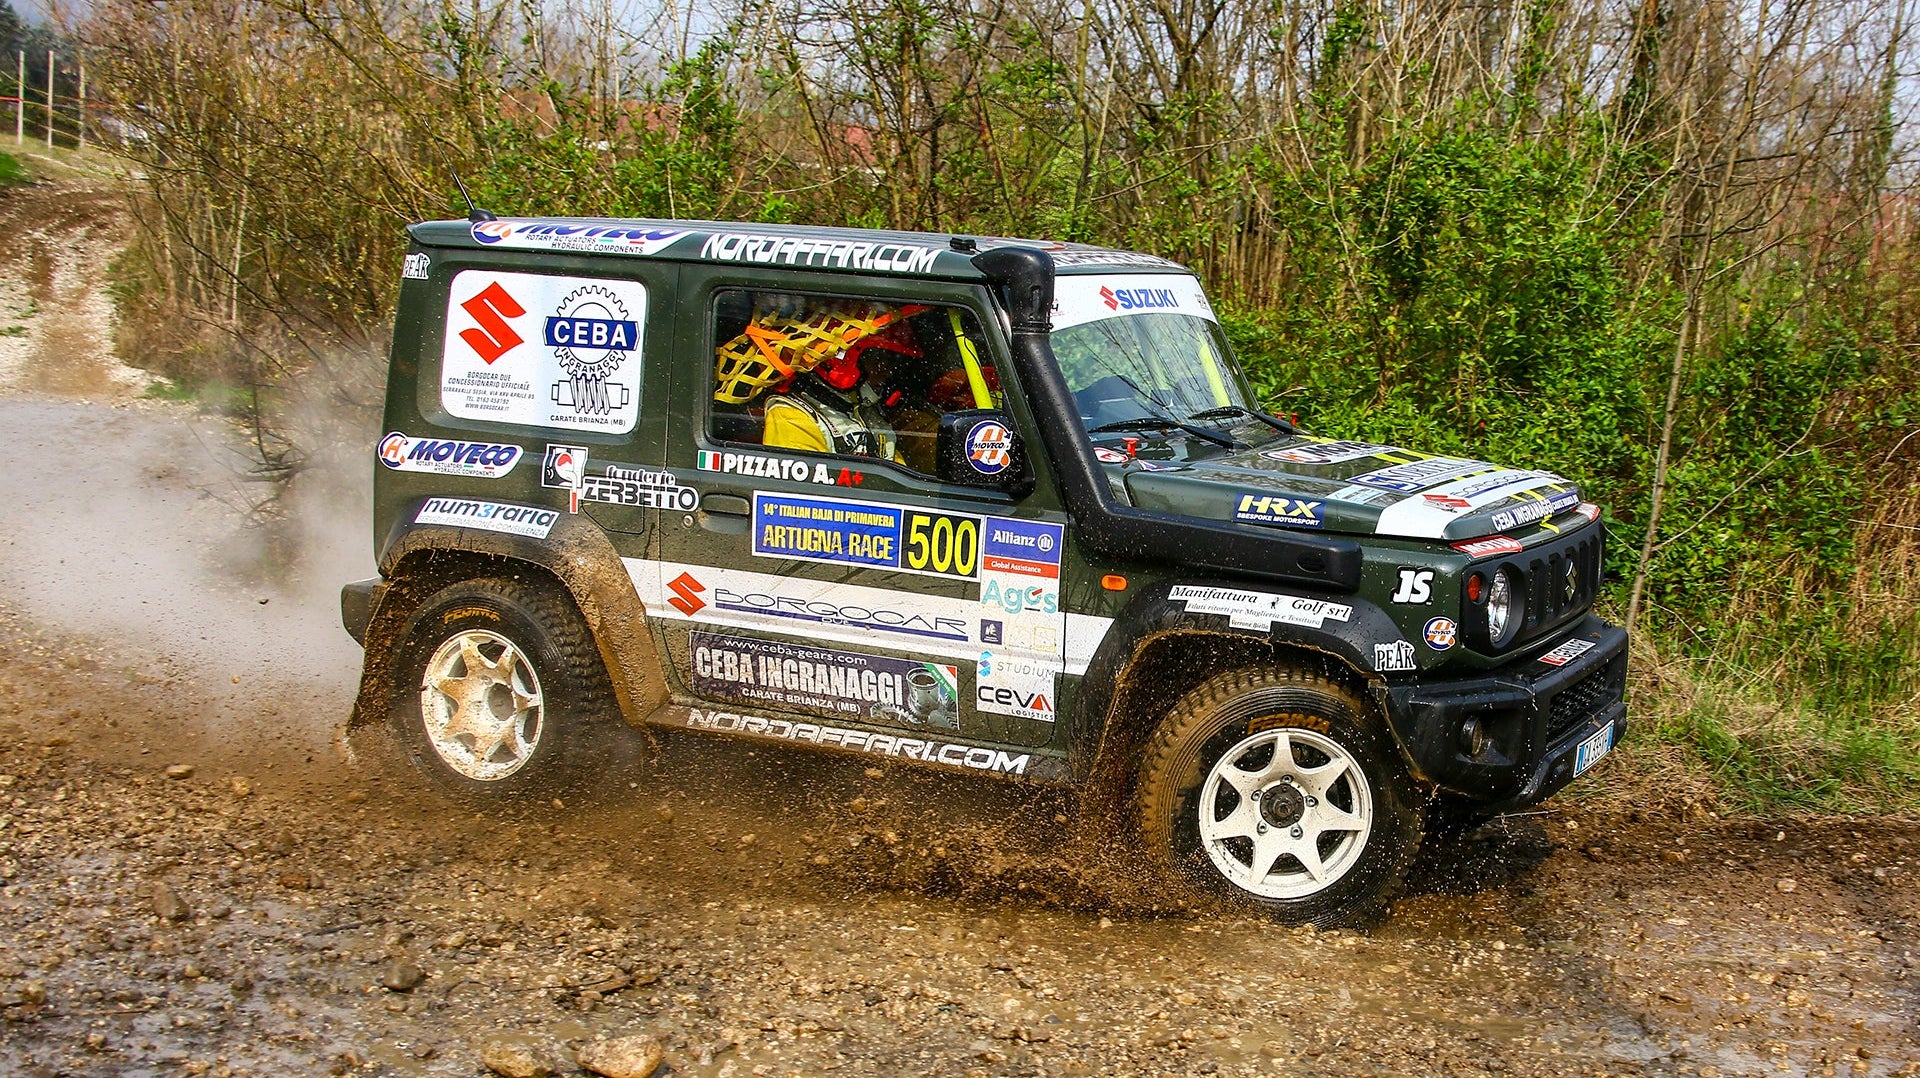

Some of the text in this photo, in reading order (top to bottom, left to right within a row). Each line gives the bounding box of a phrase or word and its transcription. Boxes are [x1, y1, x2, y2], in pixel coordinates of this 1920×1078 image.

[525, 234, 597, 244] ROTARY ACTUATORS
[551, 241, 644, 254] HYDRAULIC COMPONENTS
[700, 232, 943, 273] NORDAFFARI.COM
[1115, 288, 1180, 310] SUZUKI
[553, 320, 628, 347] CEBA
[561, 347, 619, 373] INGRANAGGI
[447, 377, 530, 391] CONCESSIONARIO UFFICIALE
[499, 373, 511, 381] DUE
[550, 414, 626, 427] CARATE BRIANZA (MB)
[407, 440, 518, 467] MOVECO
[973, 441, 1004, 449] MOVECO
[723, 453, 835, 485] PIZZATO A.
[837, 467, 864, 487] A+
[583, 478, 697, 510] ZERBETTO
[1238, 494, 1322, 519] HRX
[423, 499, 556, 527] num3raria
[762, 503, 895, 528] 14° ITALIAN BAJA DI PRIMAVERA
[1273, 515, 1321, 526] MOTORSPORT
[1491, 511, 1517, 532] CEBA
[762, 524, 894, 561] ARTUGNA RACE
[907, 514, 977, 576] 500
[992, 529, 1035, 547] Allianz
[991, 560, 1042, 574] Global Assistance
[1392, 570, 1434, 603] JS
[714, 588, 967, 635] BORGOCAR
[1170, 586, 1350, 619] Manifattura Golf srl
[1230, 606, 1243, 615] per
[1244, 608, 1280, 620] Maglieria
[1287, 614, 1322, 626] Tessitura
[723, 638, 868, 667] www.ceba-gears.com
[1376, 642, 1415, 669] PEAK
[695, 646, 904, 706] CEBA INGRANAGGI
[996, 661, 1055, 678] STUDIUM
[741, 687, 862, 715] CARATE BRIANZA (MB)
[1011, 709, 1054, 721] LOGISTICS
[685, 708, 1032, 775] NORDAFFARI.COM
